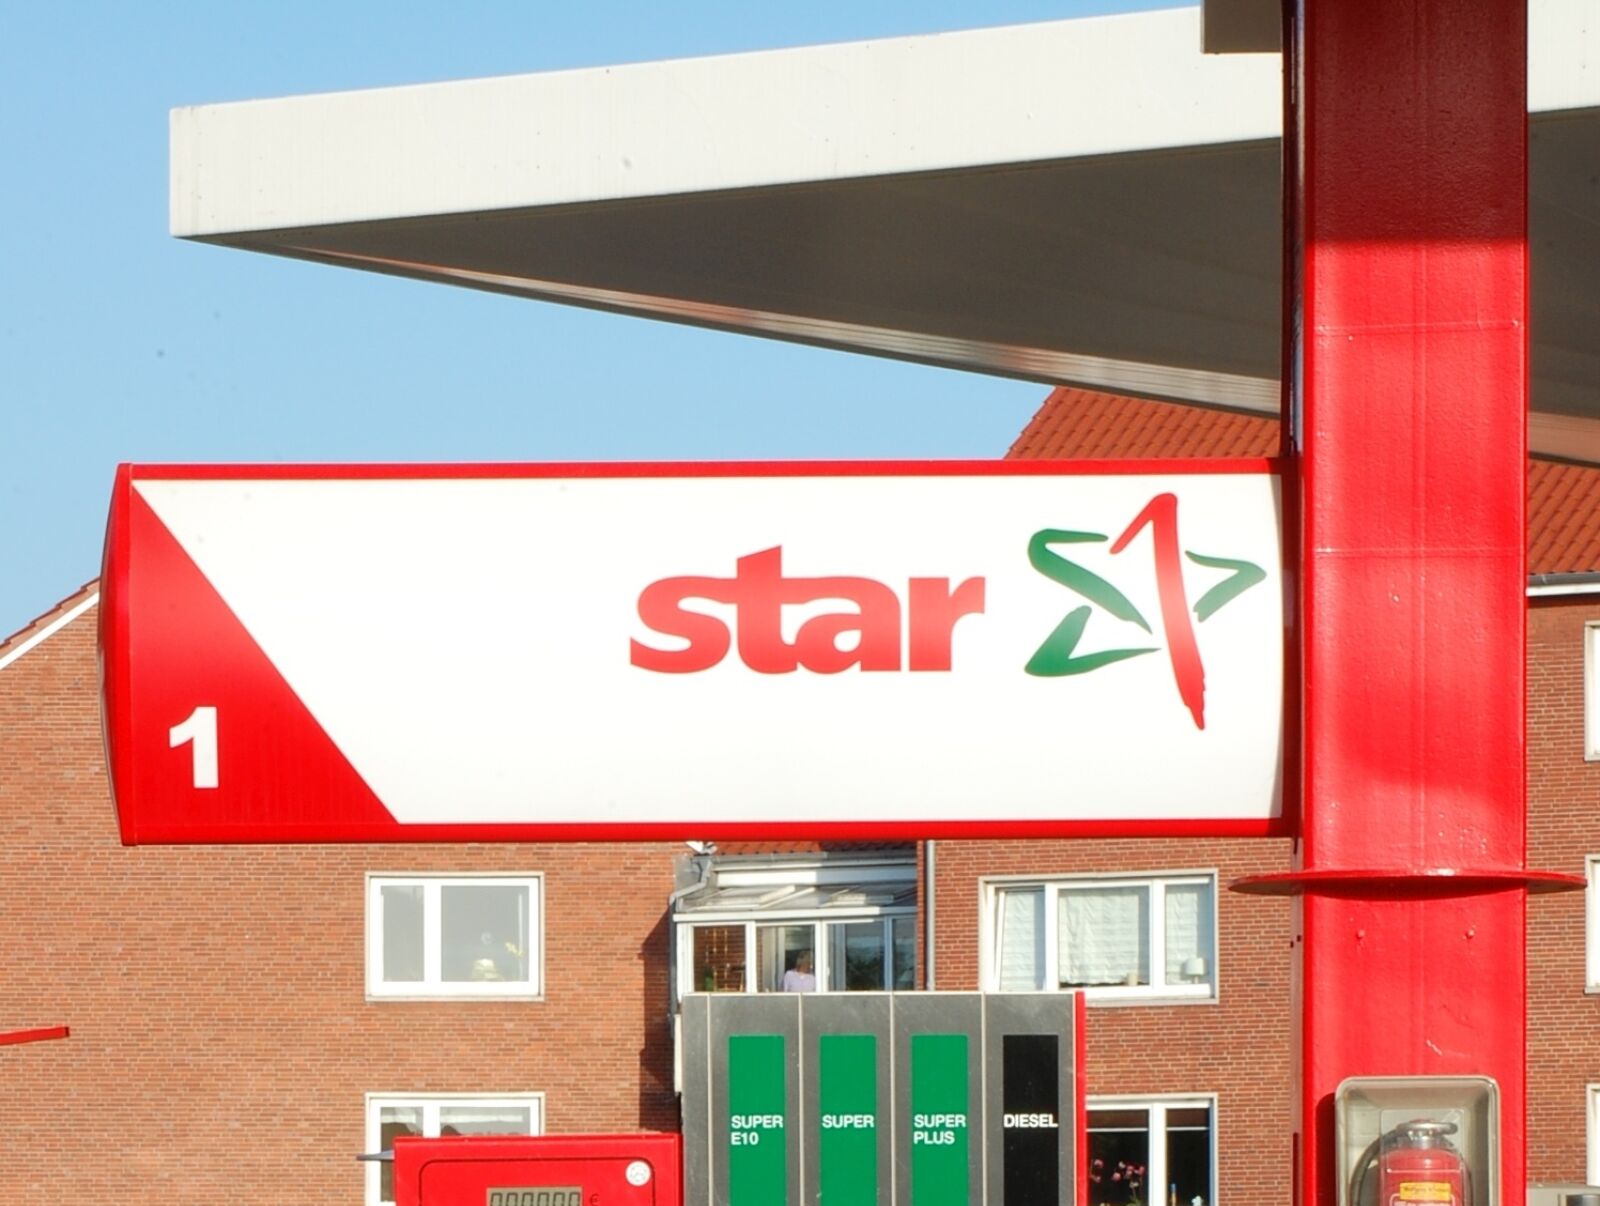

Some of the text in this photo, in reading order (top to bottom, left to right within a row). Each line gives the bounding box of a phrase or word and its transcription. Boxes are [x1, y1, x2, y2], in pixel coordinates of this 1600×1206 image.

[628, 544, 986, 674] star
[168, 706, 219, 789] 1
[731, 1115, 783, 1129] SUPER
[821, 1114, 875, 1128] SUPER
[913, 1114, 966, 1128] SUPER
[1003, 1114, 1059, 1128] DIESEL
[731, 1132, 759, 1146] E10
[913, 1131, 955, 1145] PLUS
